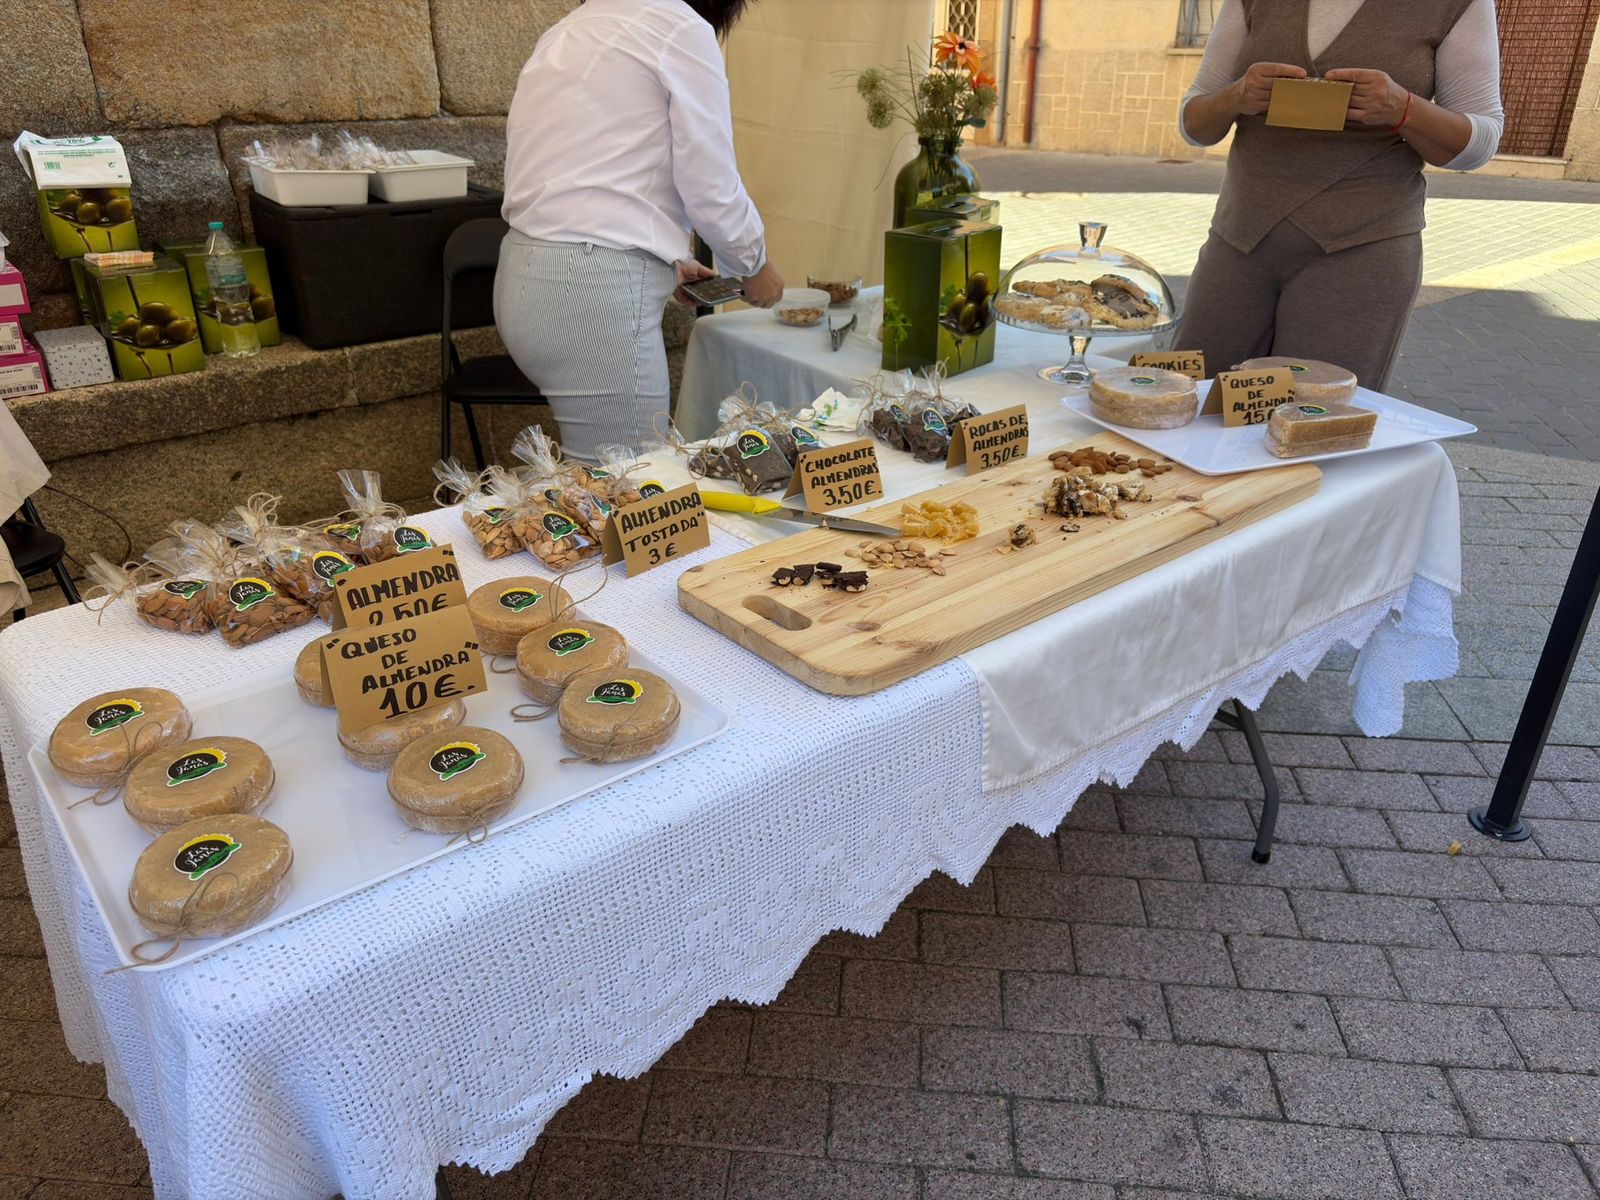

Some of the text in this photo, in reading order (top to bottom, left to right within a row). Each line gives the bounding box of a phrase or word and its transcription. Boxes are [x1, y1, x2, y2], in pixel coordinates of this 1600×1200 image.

[1247, 389, 1265, 400] DE
[368, 593, 449, 626] 250€
[381, 649, 409, 670] DE
[609, 684, 626, 692] Las
[98, 708, 119, 718] Las
[183, 758, 203, 767] Las
[440, 751, 460, 762] Las
[177, 761, 209, 775] Janas
[185, 847, 220, 867] Janas
[187, 846, 209, 859] Las
